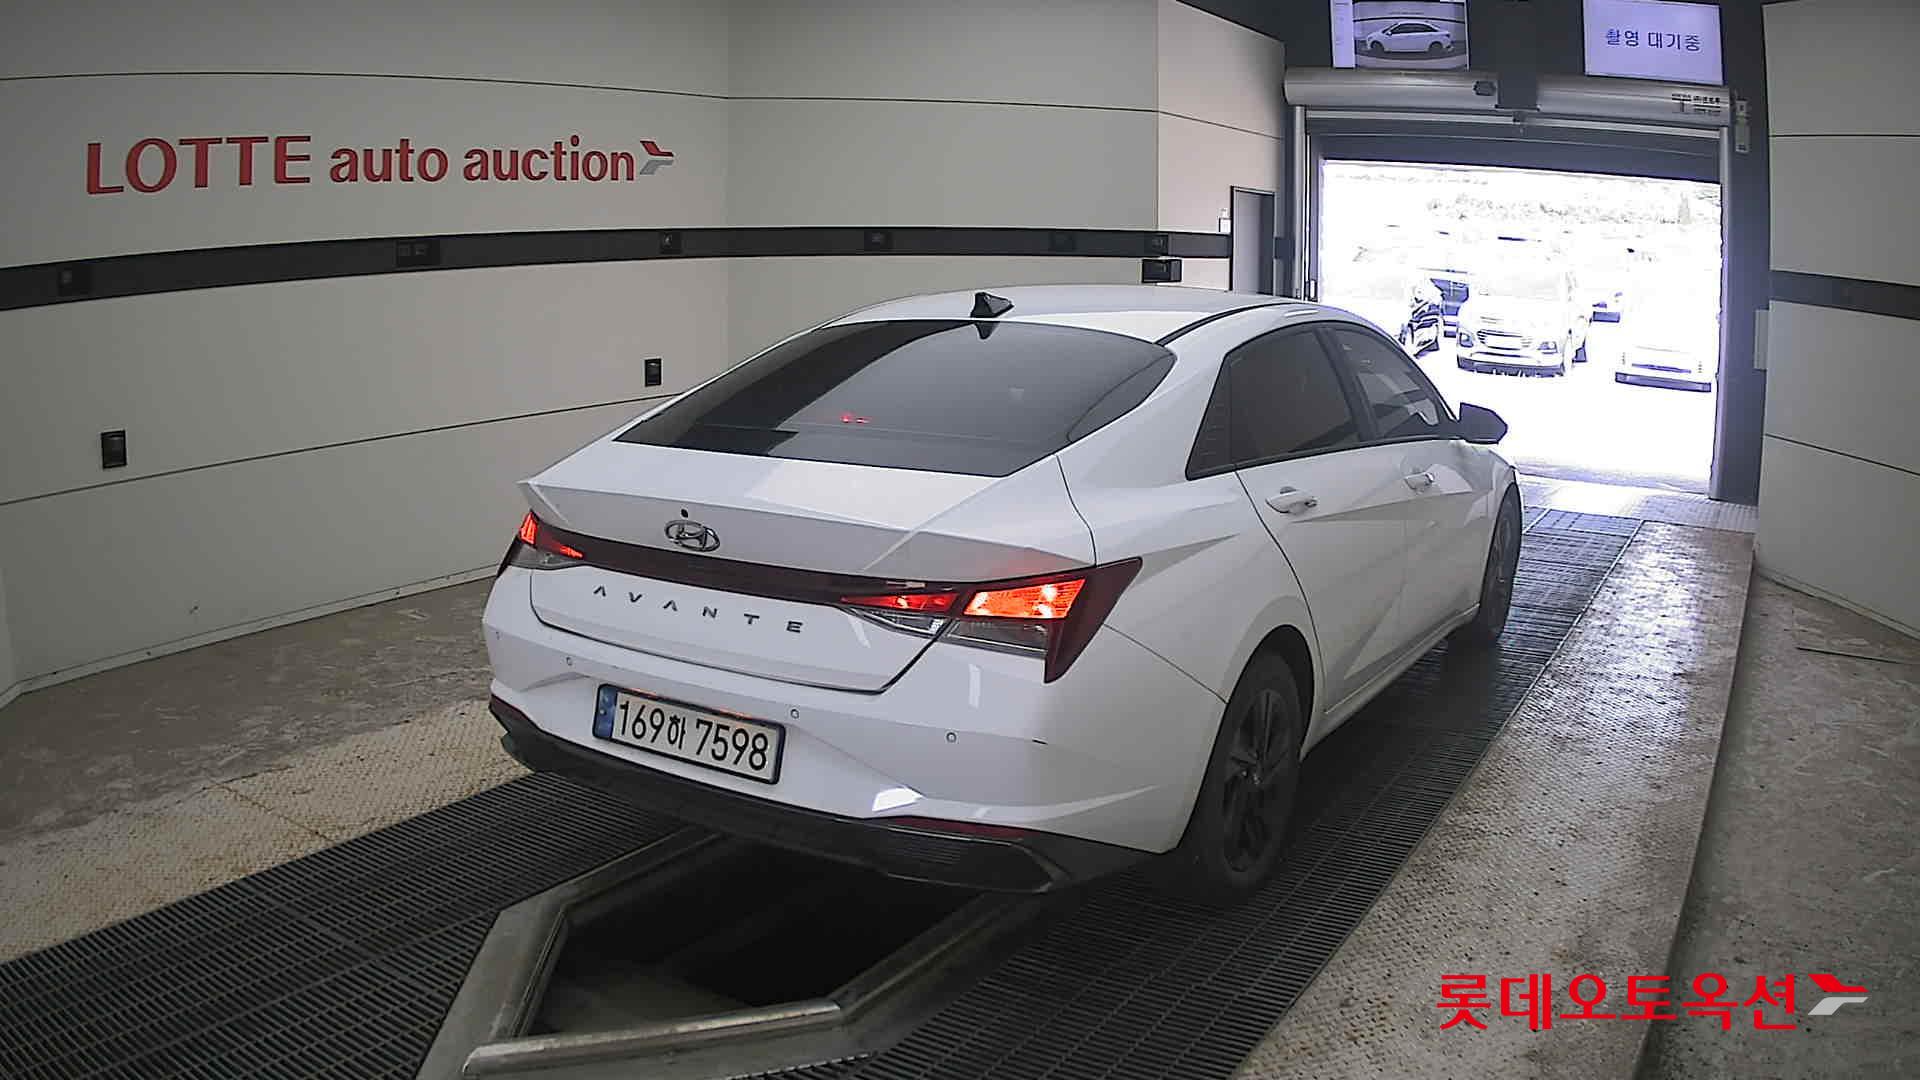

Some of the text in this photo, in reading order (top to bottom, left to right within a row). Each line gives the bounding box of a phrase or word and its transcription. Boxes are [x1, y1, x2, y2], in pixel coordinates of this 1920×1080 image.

[1605, 28, 1701, 52] 촬영 대기중
[86, 135, 635, 195] LOTTE auto auction
[593, 585, 804, 634] AVANTE
[618, 699, 769, 772] 169하 7598
